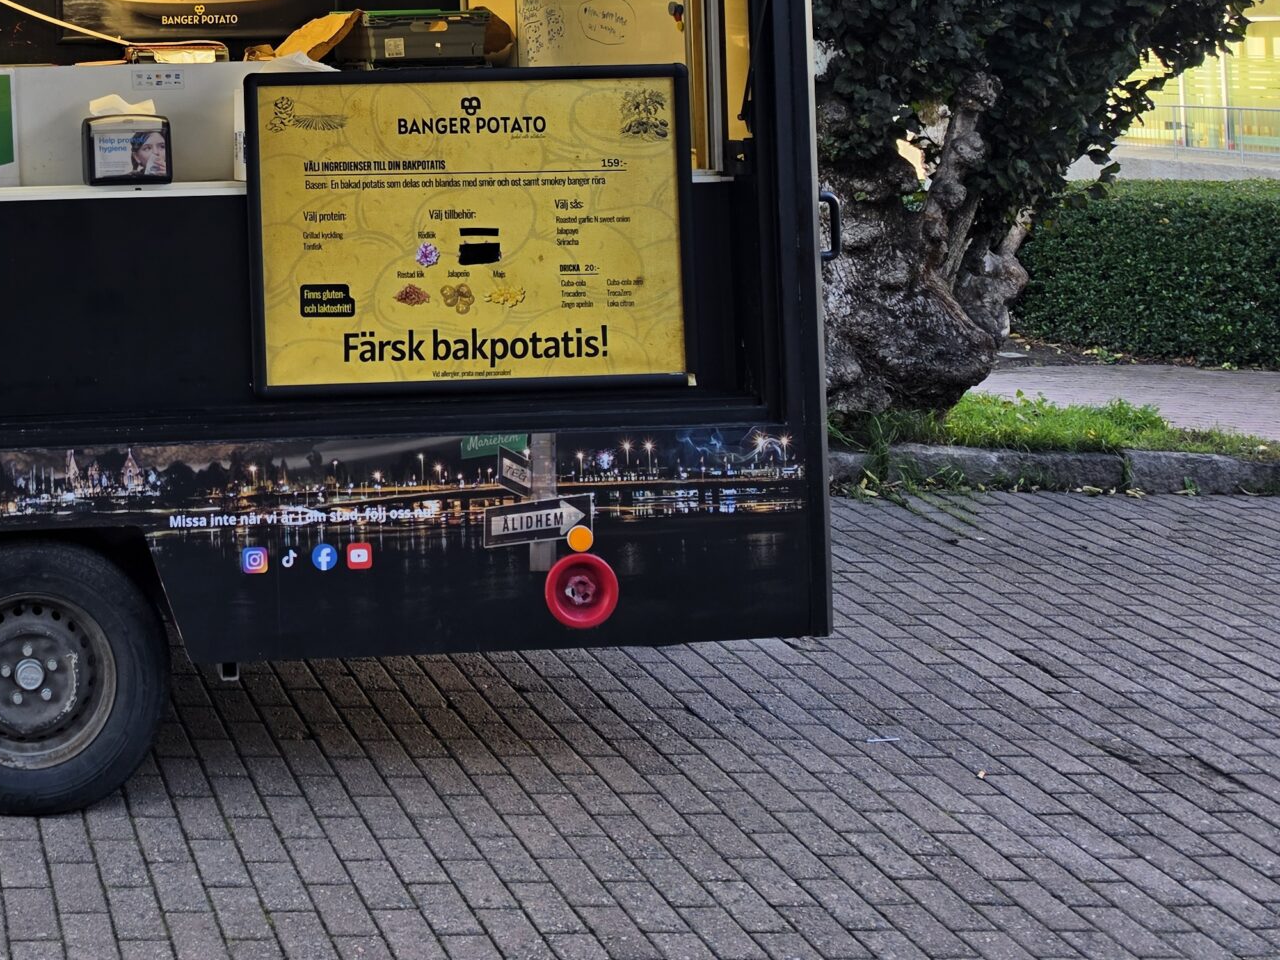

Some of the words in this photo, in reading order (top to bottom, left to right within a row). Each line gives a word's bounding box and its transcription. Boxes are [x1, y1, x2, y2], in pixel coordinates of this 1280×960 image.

[161, 15, 199, 25] BANGER
[201, 14, 238, 24] POTATO
[397, 117, 470, 134] BANGER
[476, 116, 546, 133] POTATO
[304, 160, 320, 172] VÄLJ
[322, 161, 371, 171] INGREDIENSER
[373, 161, 386, 171] TILL
[388, 161, 400, 170] DIN
[402, 160, 445, 170] BAKPOTATIS
[601, 158, 627, 167] 159:-
[305, 180, 327, 189] Basen:
[331, 180, 339, 189] En
[340, 180, 361, 189] bakad
[362, 179, 385, 190] potatis
[403, 179, 420, 188] delas
[422, 179, 433, 187] och
[435, 178, 461, 187] blandas
[462, 178, 477, 187] med
[479, 177, 496, 187] smör
[497, 177, 509, 186] och
[511, 178, 521, 186] ost
[523, 177, 539, 186] samt
[541, 177, 566, 187] smokey
[567, 176, 590, 186] banger
[592, 176, 606, 185] röra
[554, 199, 568, 210] Välj
[303, 211, 317, 222] Välj
[319, 212, 347, 222] protein:
[429, 210, 442, 220] Välj
[445, 209, 476, 219] tillbehör:
[616, 215, 631, 223] onion
[556, 238, 579, 246] Sriracha
[560, 264, 580, 272] DRICKA
[304, 290, 321, 299] Finns
[323, 290, 346, 300] gluten-
[304, 304, 316, 313] och
[318, 303, 352, 313] laktosfritt!
[343, 330, 425, 362] Färsk
[432, 325, 608, 367] bakpotatis!
[170, 515, 207, 528] Missa
[240, 512, 261, 524] när
[266, 511, 277, 524] vi
[330, 509, 362, 522] stad,
[365, 506, 387, 522] följ
[390, 509, 410, 519] oss
